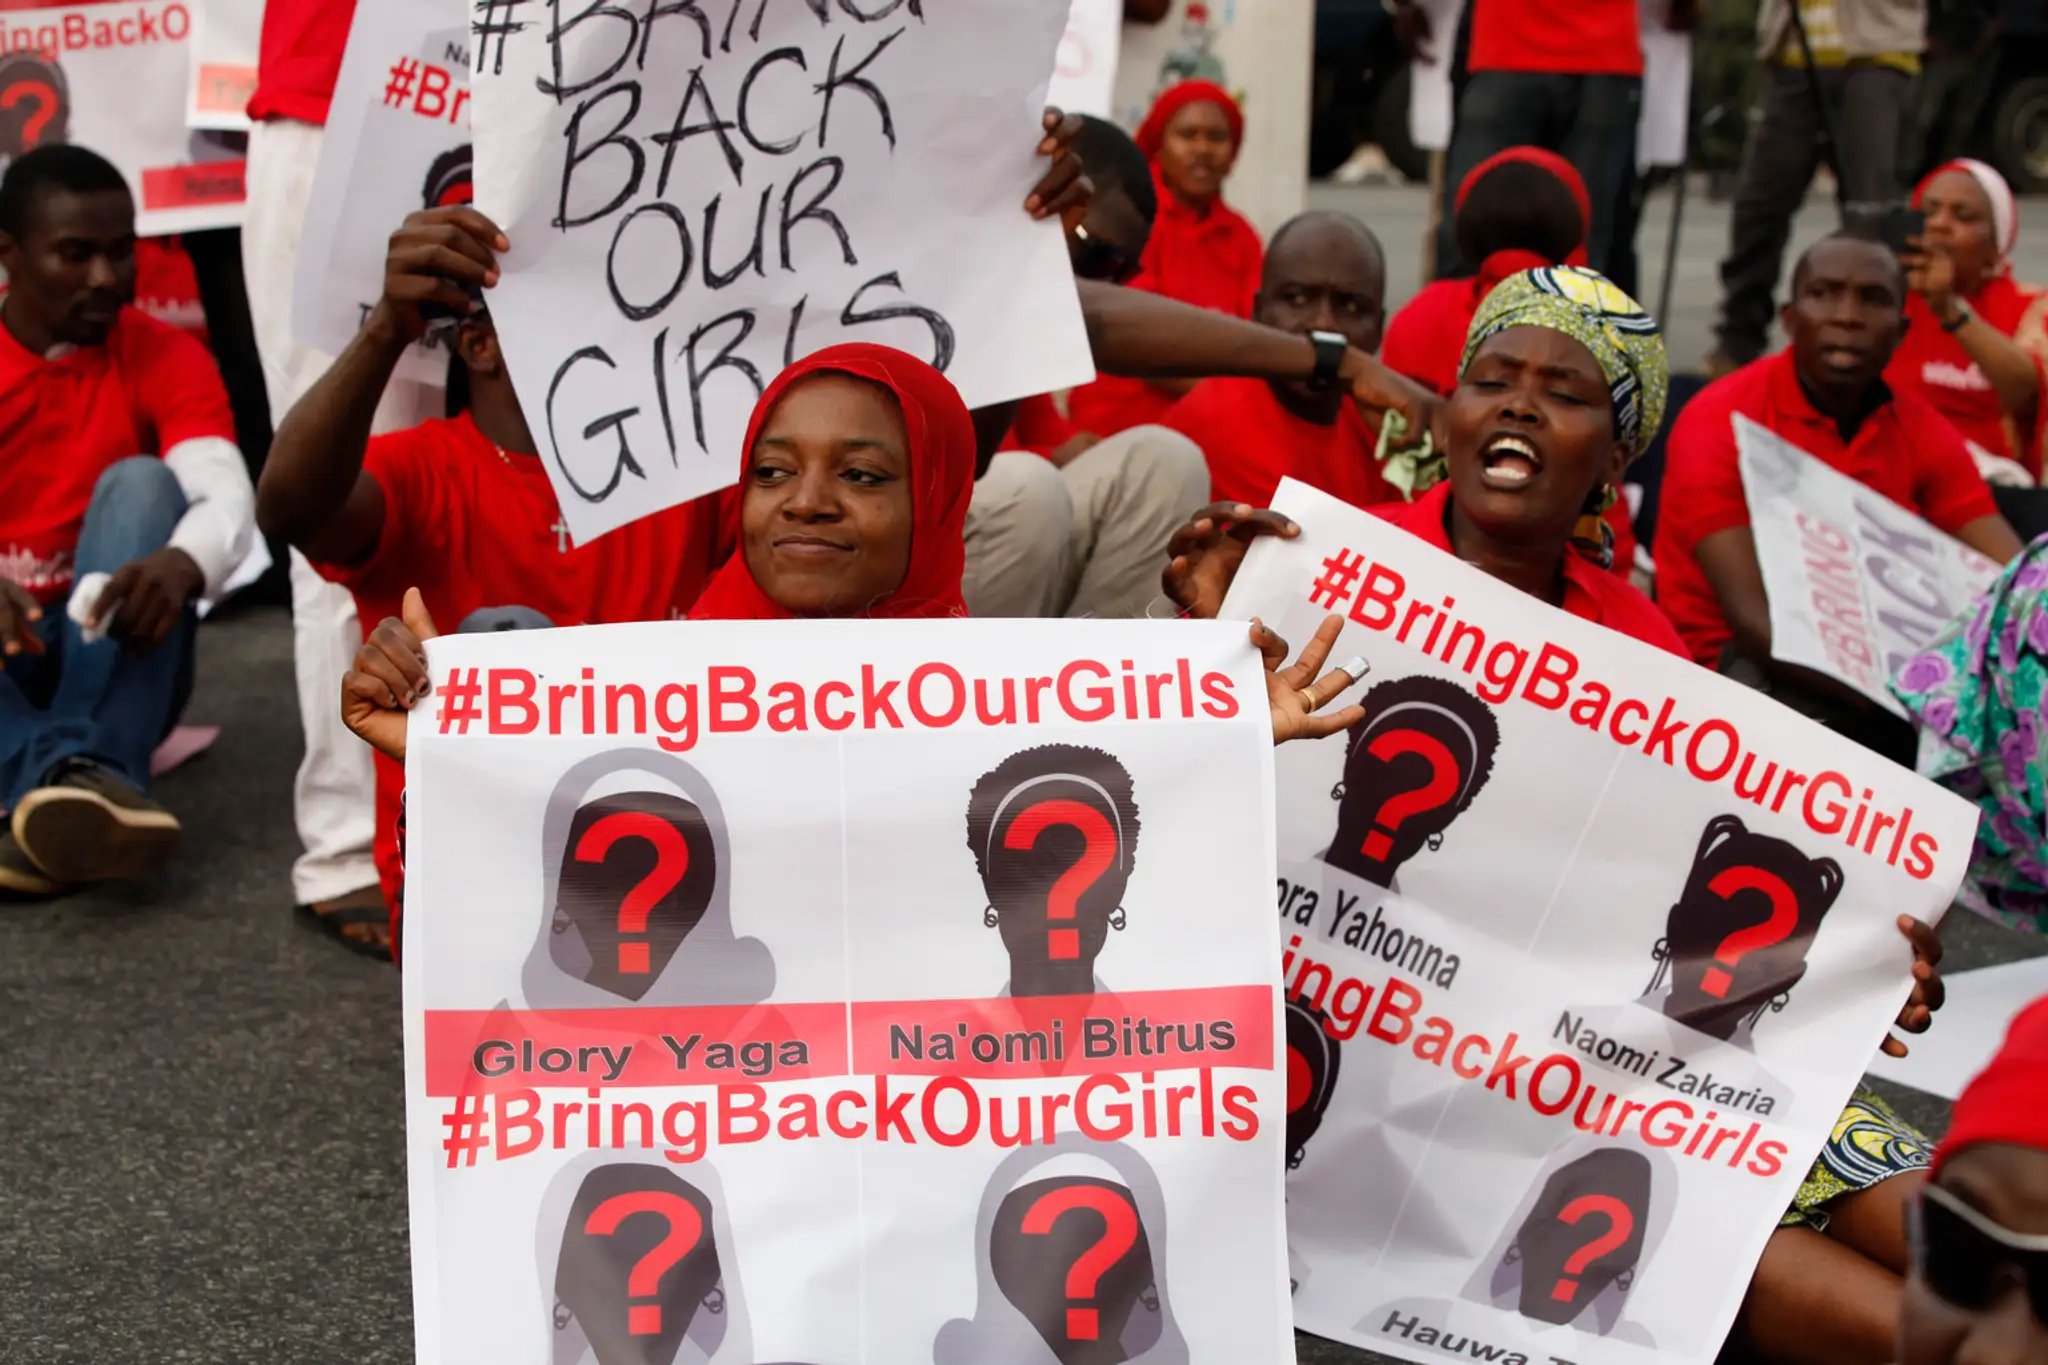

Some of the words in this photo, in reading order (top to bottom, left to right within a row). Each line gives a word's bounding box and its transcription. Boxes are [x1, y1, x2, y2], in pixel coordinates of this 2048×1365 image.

[551, 26, 906, 232] BACK
[606, 155, 858, 321] OUR
[436, 657, 1241, 752] #BringBackOurGirls
[1308, 546, 1940, 881] #BringBackOurGirls
[1327, 888, 1461, 992] Yahonna
[472, 1039, 634, 1081] Glory
[660, 1034, 811, 1077] Yaga
[889, 1019, 1064, 1064] Na'omi
[1082, 1017, 1237, 1059] Bitrus
[1552, 1009, 1660, 1078] Naomi
[1655, 1056, 1777, 1117] Zakaria
[441, 1067, 1260, 1169] #BringBackOurGirls
[1380, 1309, 1530, 1365] Hauwa
